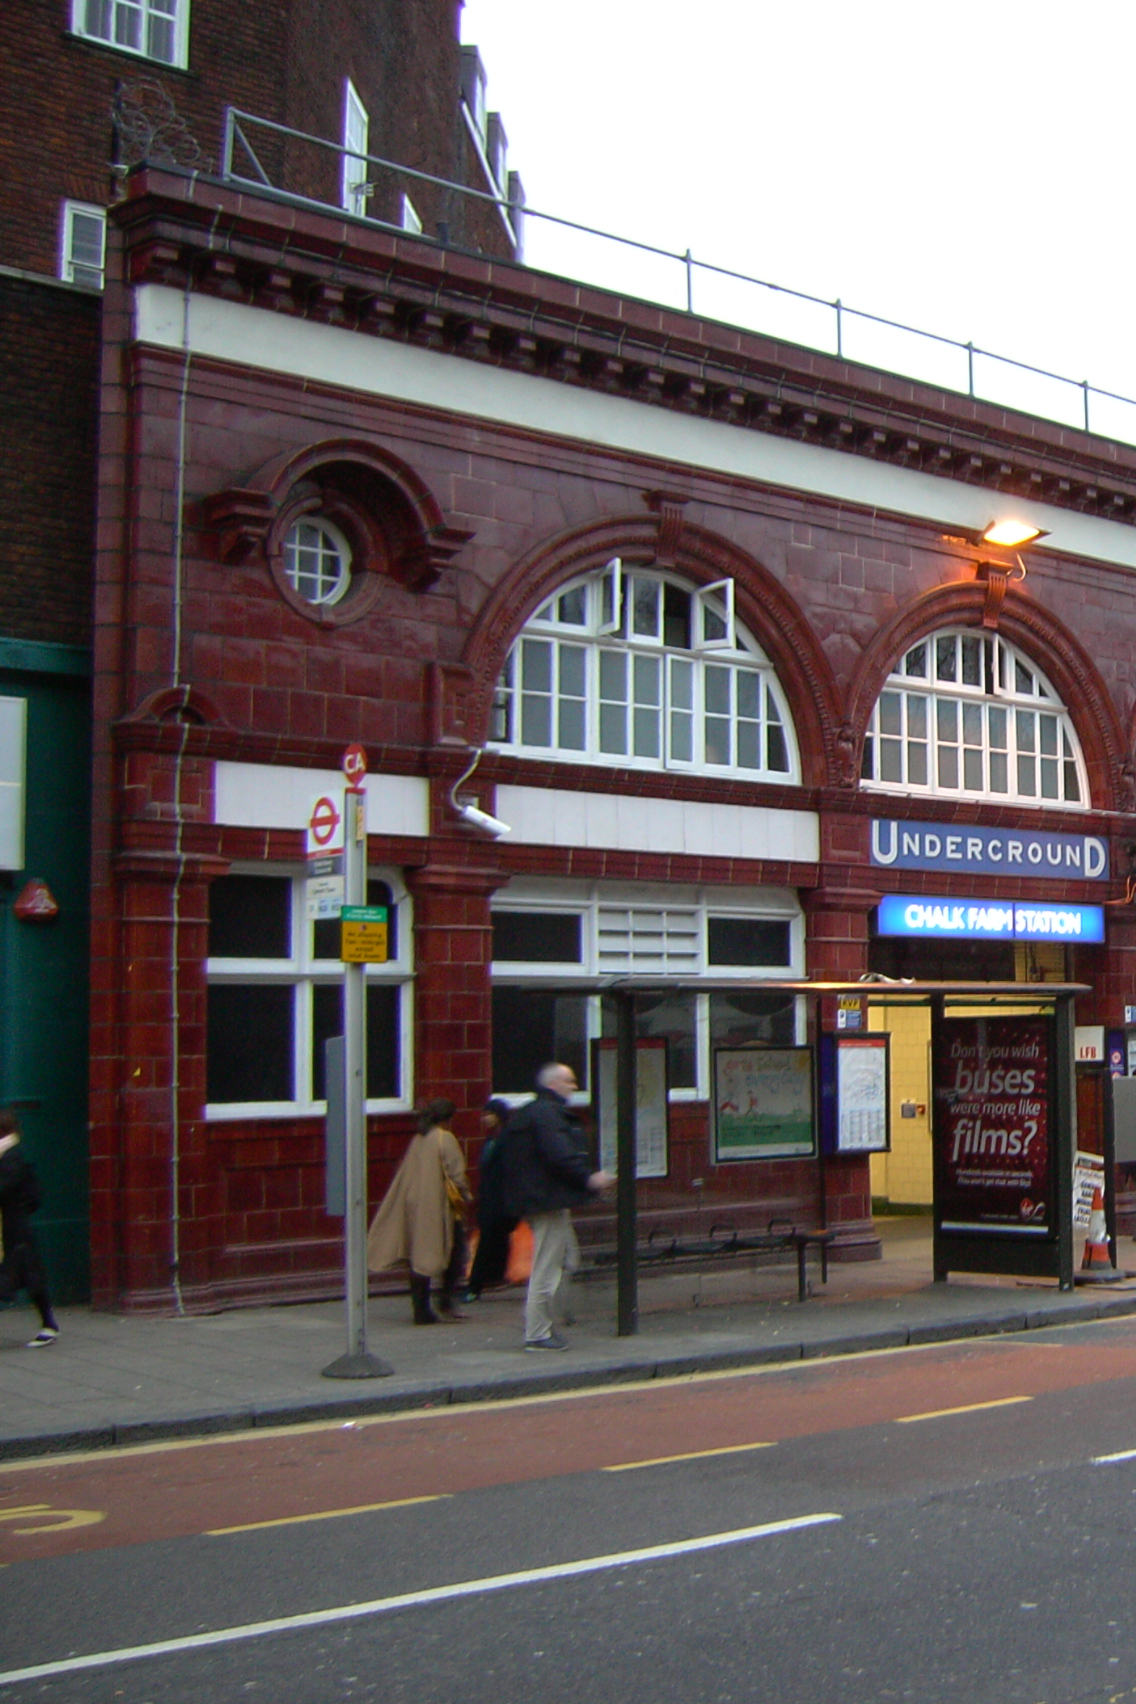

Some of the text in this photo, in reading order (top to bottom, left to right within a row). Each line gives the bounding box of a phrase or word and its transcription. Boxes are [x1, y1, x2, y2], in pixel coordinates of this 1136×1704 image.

[344, 752, 366, 774] CA
[904, 904, 1082, 935] CHALK FARM STATION
[950, 1042, 1039, 1061] Don't you wish
[1080, 1046, 1097, 1059] LFB
[955, 1060, 1036, 1095] buses
[950, 1098, 1041, 1116] were more like
[952, 1118, 1038, 1162] films?
